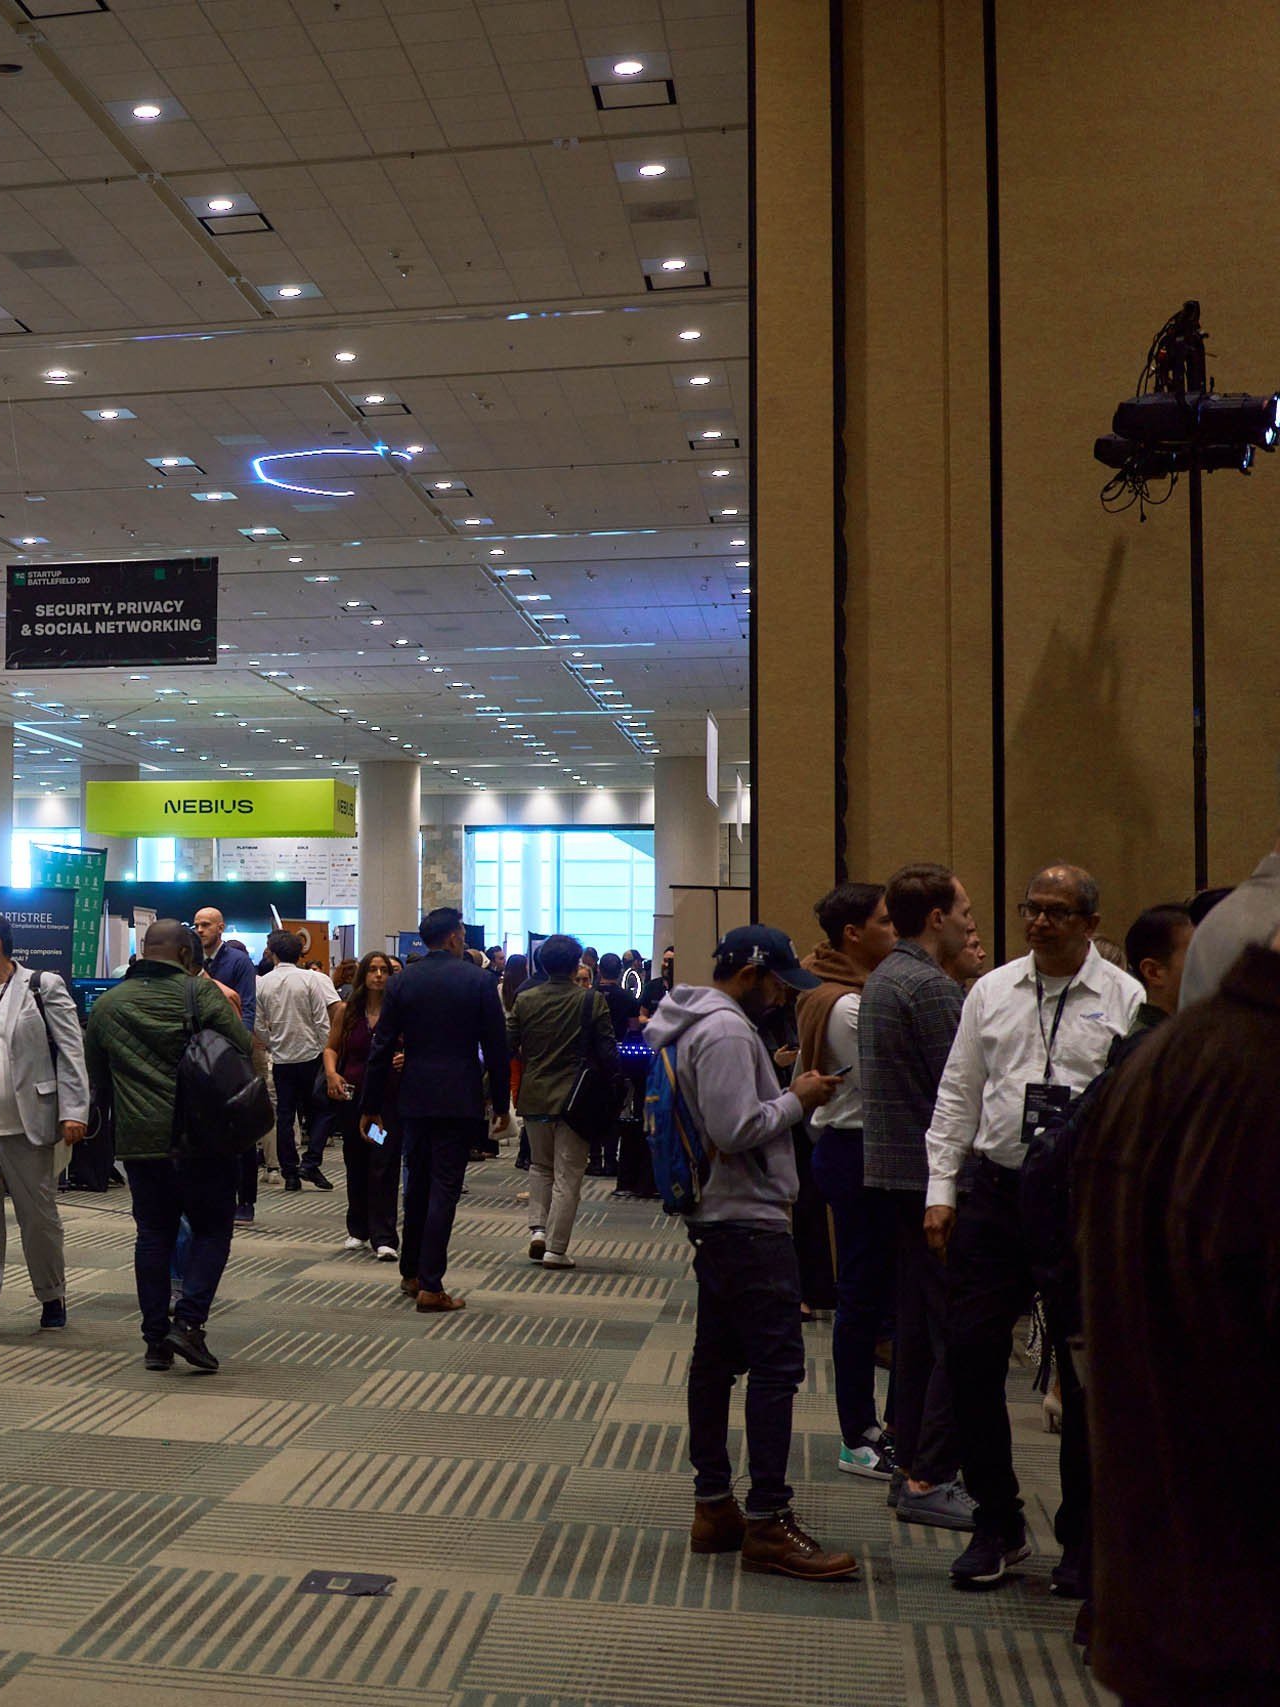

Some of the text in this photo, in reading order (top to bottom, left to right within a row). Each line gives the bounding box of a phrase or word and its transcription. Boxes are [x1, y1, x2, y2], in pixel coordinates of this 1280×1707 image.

[27, 570, 62, 579] STARTUP
[27, 578, 76, 586] BATTLEFIELD
[35, 600, 184, 617] SECURITY, PRIVACY
[21, 618, 202, 636] & SOCIAL NETWORKING
[164, 800, 254, 814] NEBIUS
